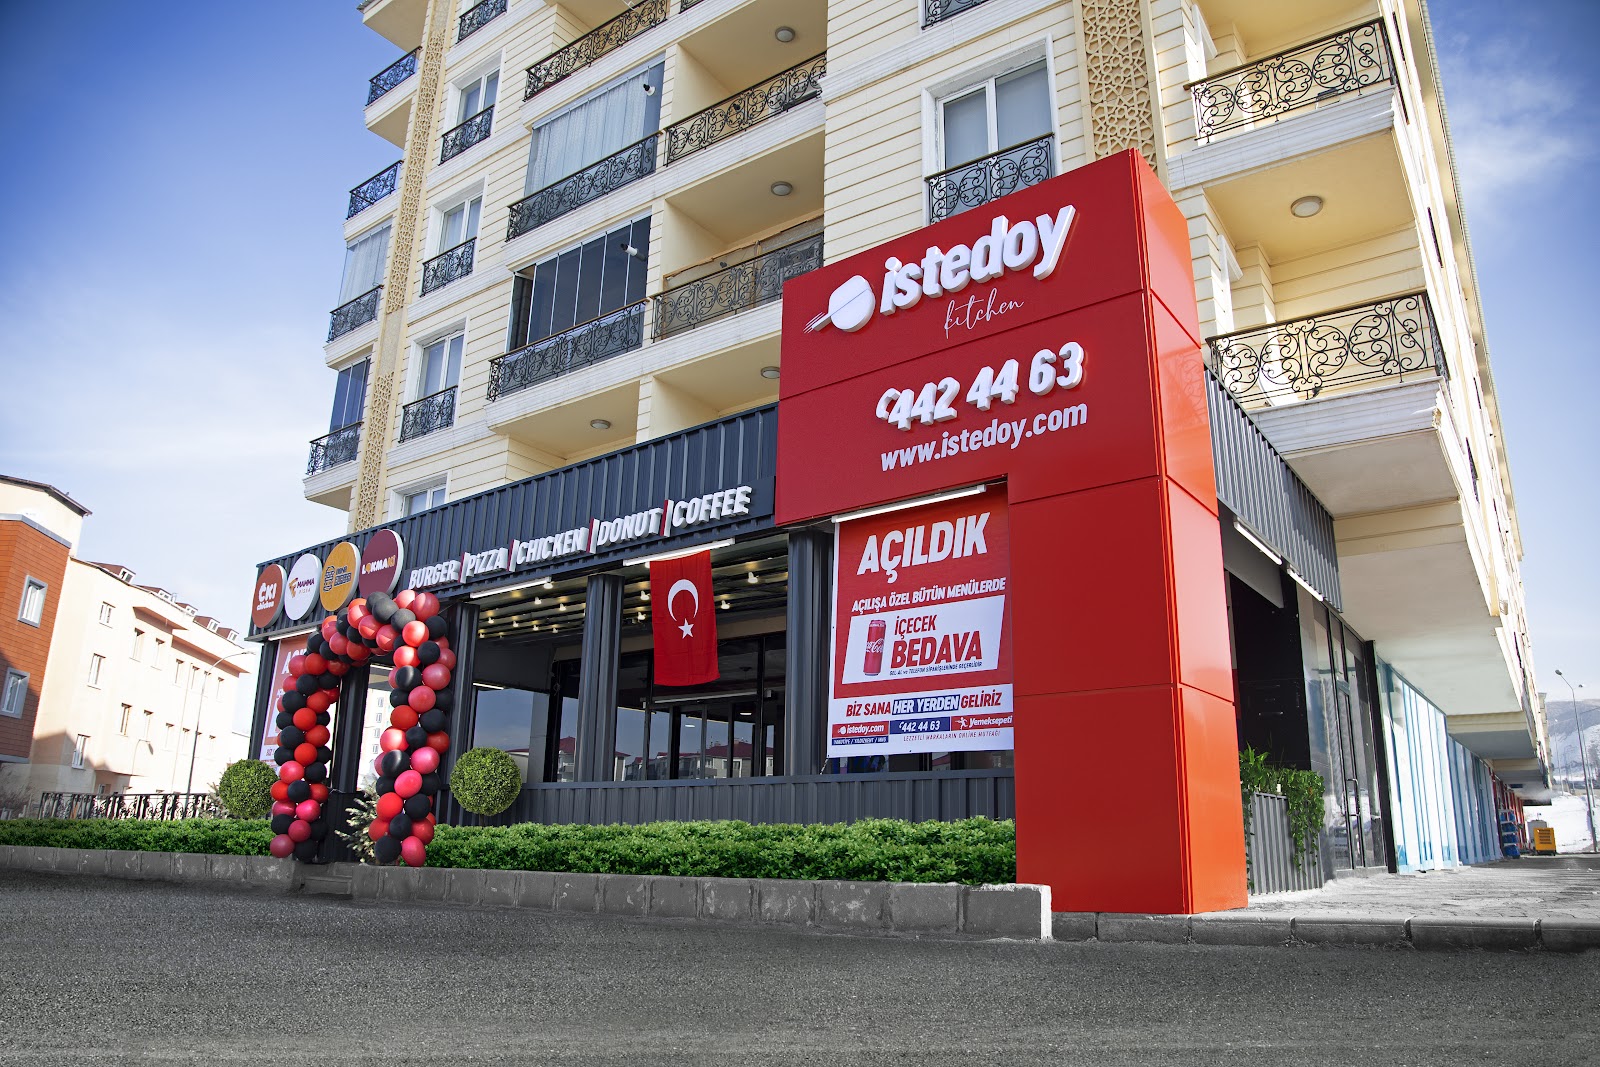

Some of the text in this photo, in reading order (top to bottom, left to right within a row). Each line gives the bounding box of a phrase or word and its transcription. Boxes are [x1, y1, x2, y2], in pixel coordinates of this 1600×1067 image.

[880, 204, 1076, 315] istedoy
[944, 288, 1025, 339] kitchen
[888, 342, 1085, 431] 442 44 63
[881, 403, 1088, 472] www.istedoy.com
[408, 559, 461, 590] BURGER
[516, 527, 590, 566] CHICKEN
[596, 507, 664, 547] DONUT
[671, 485, 752, 528] COFFEE
[857, 512, 990, 583] AÇILDIK
[852, 577, 1006, 614] AÇILIŞA ÖZEL BÜTÜN MENÜLERDE
[894, 615, 938, 639] İÇECEK
[891, 631, 983, 669] BEDAVA
[846, 690, 1002, 717] BİZ SANA HER YERDEN GELİRİZ
[969, 715, 1013, 728] Yemeksepeti
[847, 724, 884, 735] istedoy.com
[901, 720, 940, 732] 442 44 63
